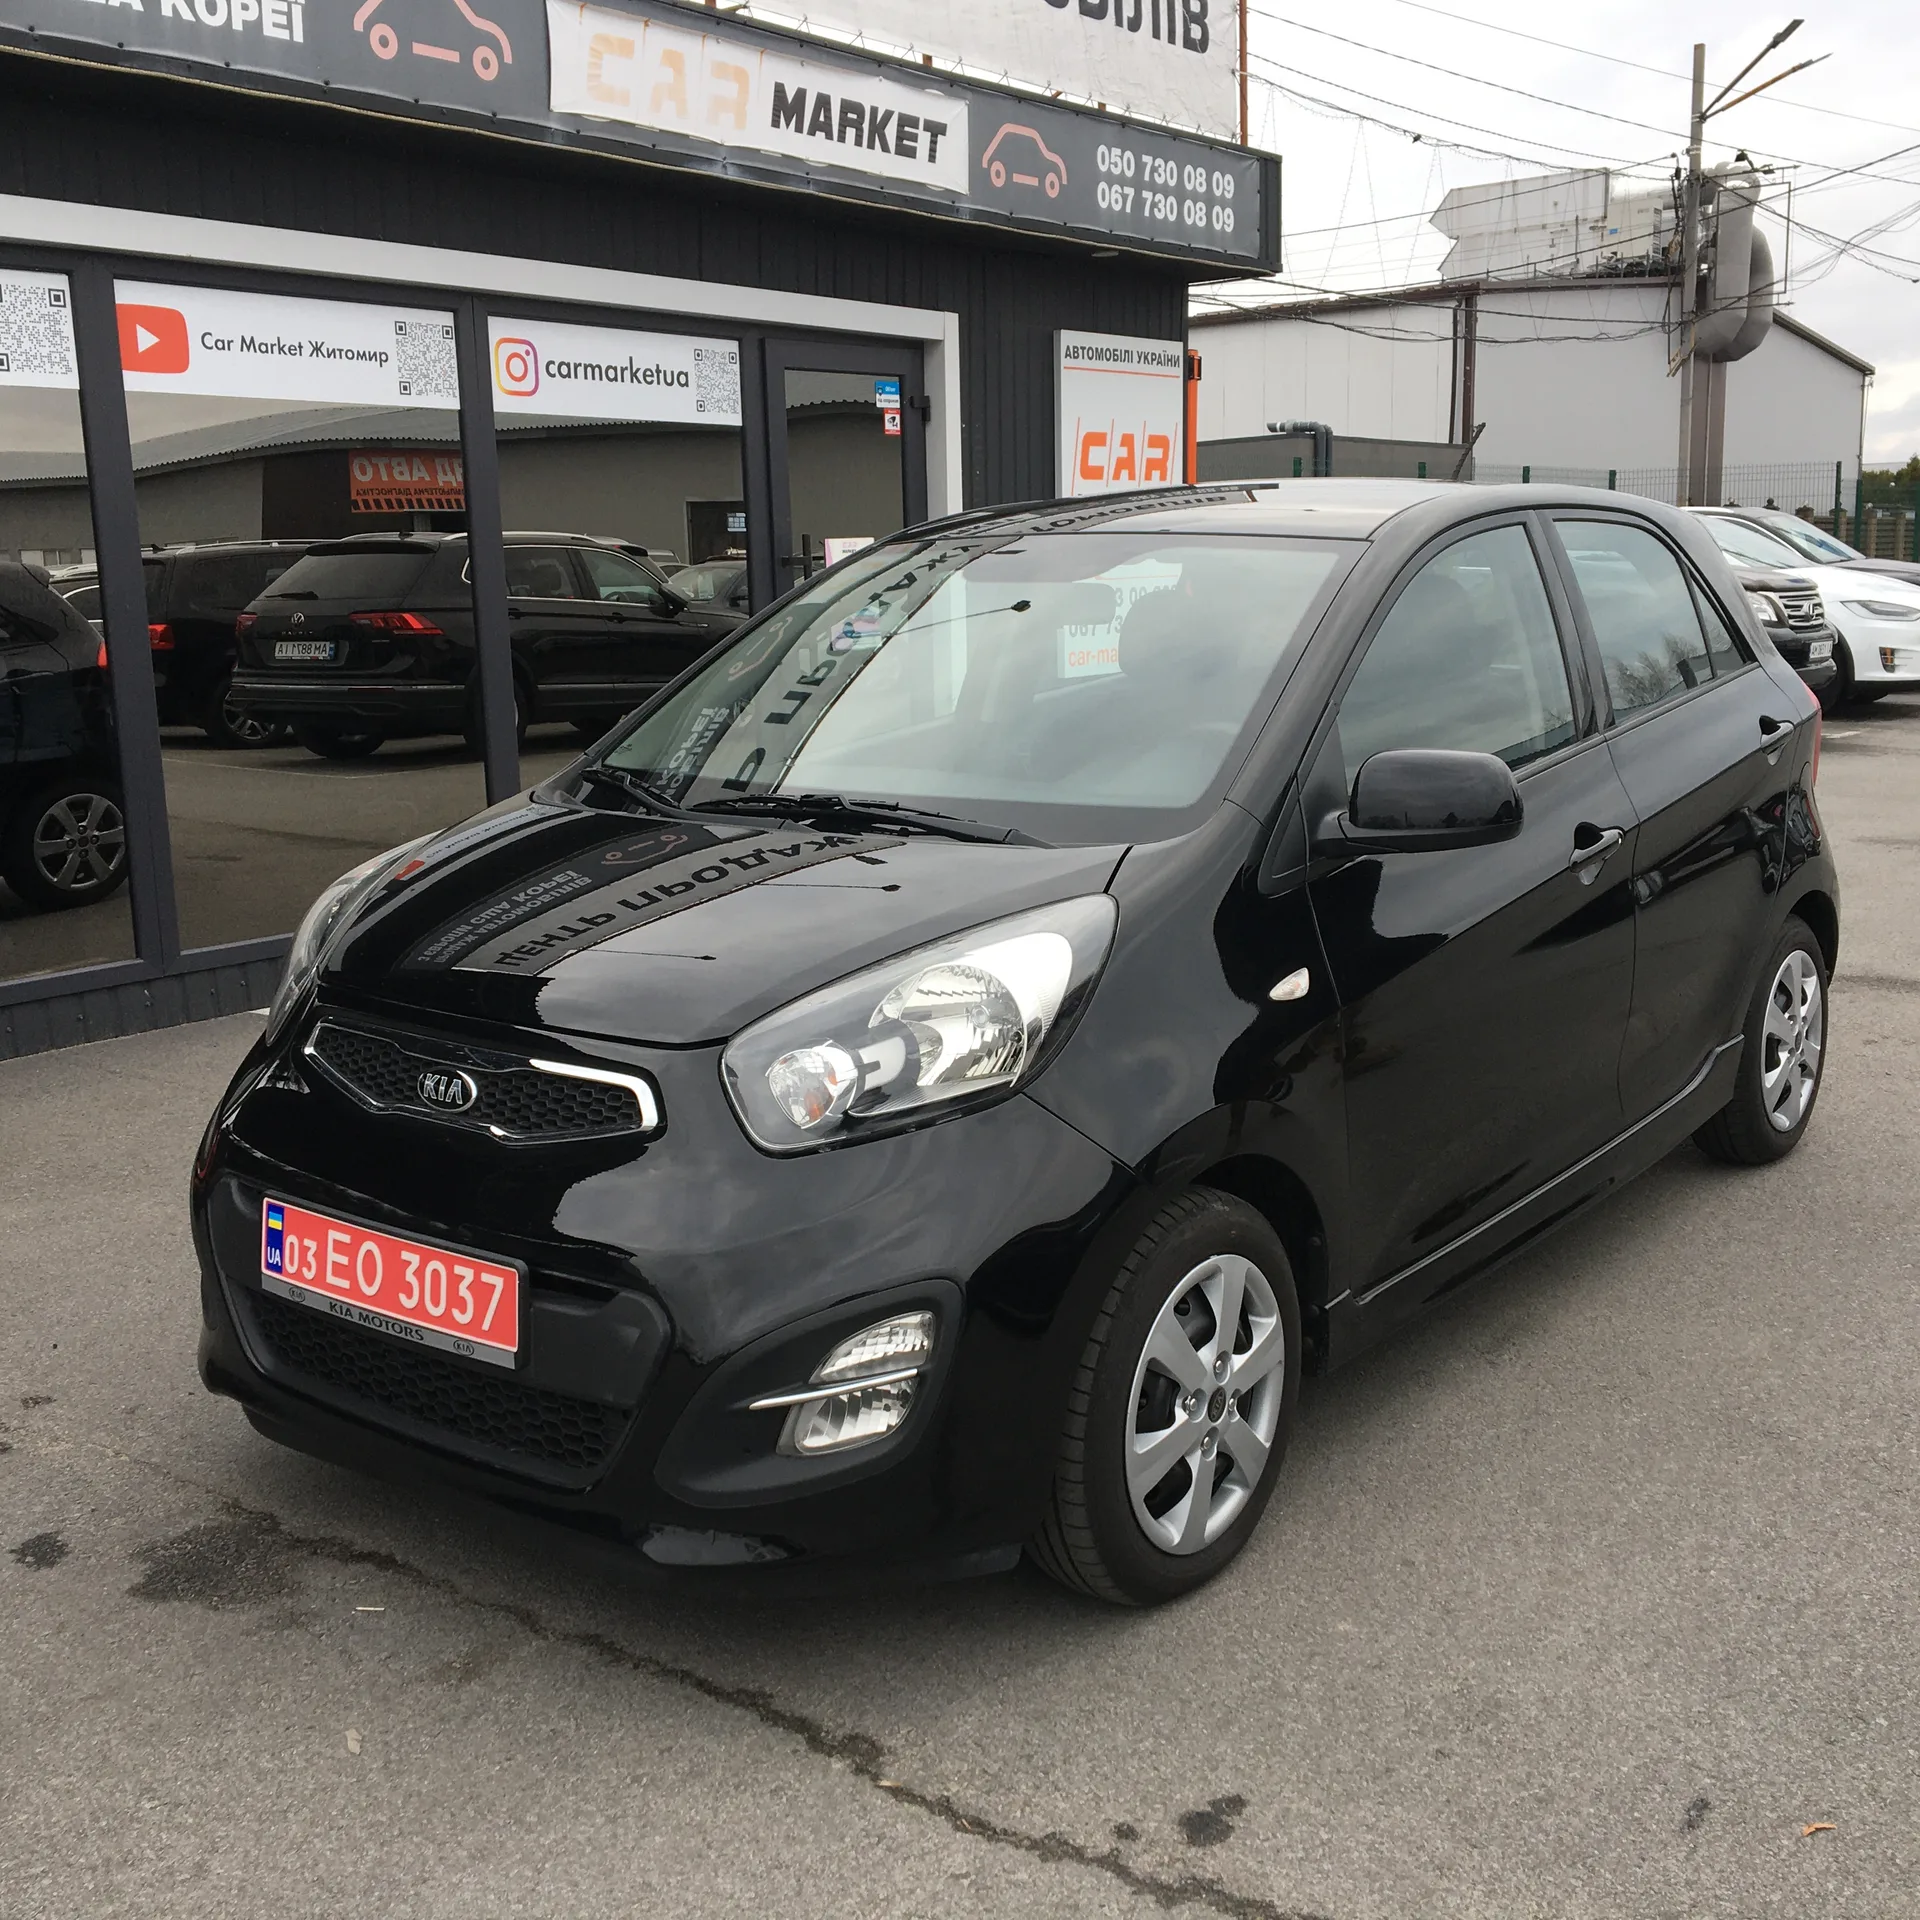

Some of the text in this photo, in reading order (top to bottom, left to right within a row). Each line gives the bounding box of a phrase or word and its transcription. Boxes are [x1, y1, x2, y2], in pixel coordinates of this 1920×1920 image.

[586, 33, 948, 164] CAR MARKET
[1097, 144, 1235, 199] 050 730 08 09
[1097, 181, 1235, 232] 067 730 08 09
[200, 332, 389, 368] Car Market Житомир
[1064, 345, 1180, 368] АВТОМОБІЛІ УКРАЇНИ
[545, 356, 689, 387] carmarketua
[1079, 432, 1170, 482] CAR
[423, 1073, 463, 1104] KIA
[267, 1246, 281, 1266] UA
[284, 1234, 317, 1281] 03
[398, 1250, 504, 1332] 3037
[329, 1301, 424, 1342] KIA MOTORS
